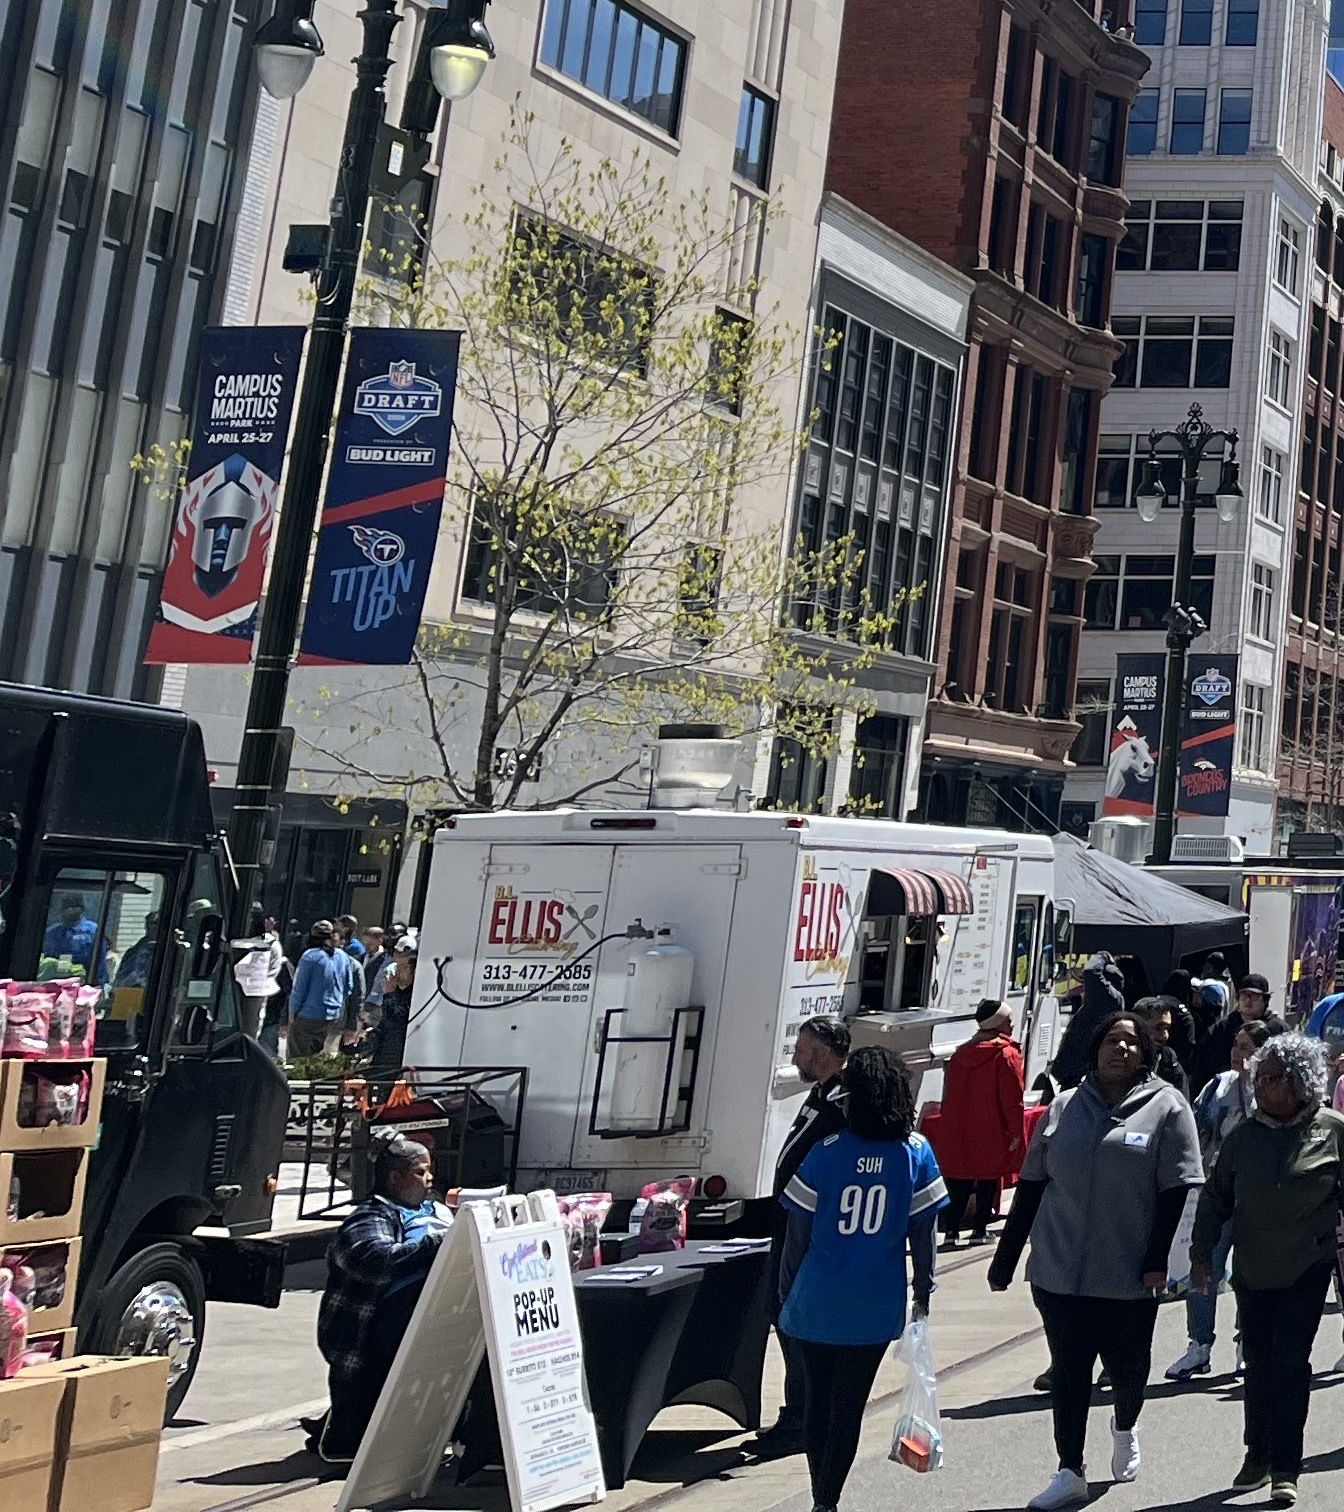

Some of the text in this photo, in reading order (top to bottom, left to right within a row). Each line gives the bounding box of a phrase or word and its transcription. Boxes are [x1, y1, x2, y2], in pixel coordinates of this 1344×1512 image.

[214, 374, 283, 397] CAMPUS
[393, 373, 411, 385] NFL
[210, 397, 280, 419] MARTIUS
[361, 393, 435, 409] DRAFT
[229, 419, 254, 428] PARK
[207, 432, 274, 444] APRIL 25-27
[349, 449, 432, 462] BUD LIGHT
[330, 559, 416, 603] TITAN
[353, 593, 397, 632] UP
[1123, 676, 1158, 688] CAMPUS
[1196, 684, 1228, 693] DRAFT
[1123, 687, 1157, 699] MARTIUS
[1181, 768, 1225, 787] BRONCOS
[1186, 779, 1229, 797] COUNTRY
[495, 885, 518, 899] B.L.
[488, 899, 565, 944] ELLIS
[794, 882, 845, 962] ELLIS
[856, 1157, 884, 1174] SUH
[838, 1184, 887, 1235] 90
[513, 1287, 555, 1311] POP-UP
[515, 1303, 560, 1337] MENU
